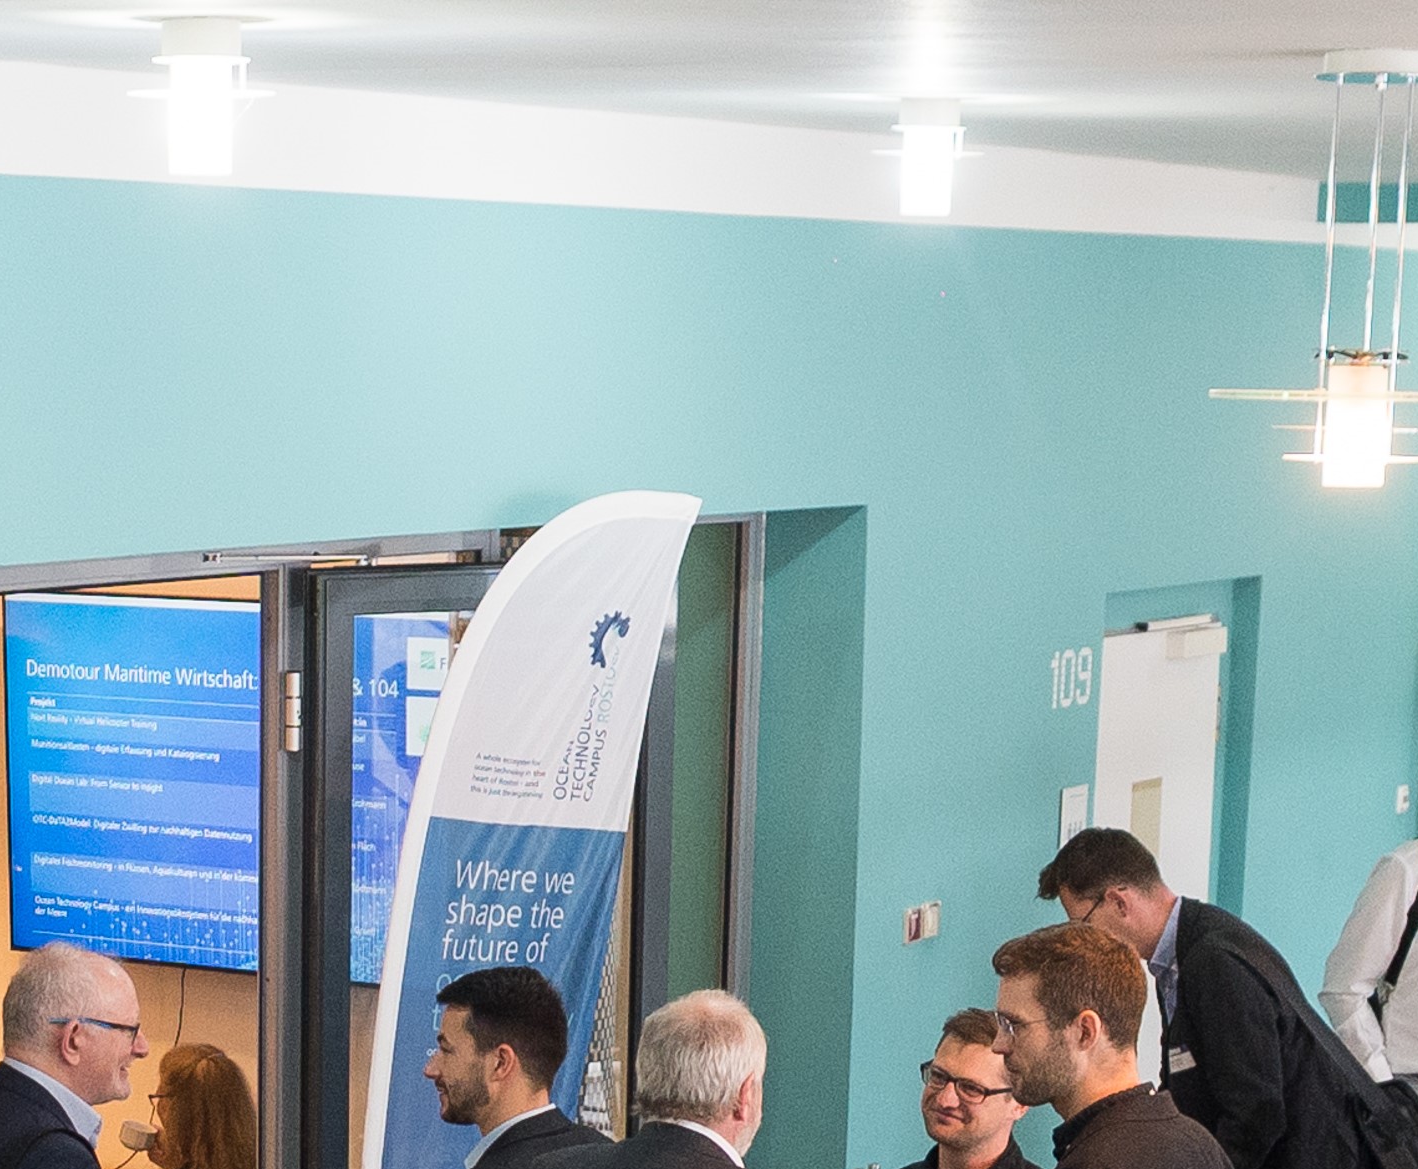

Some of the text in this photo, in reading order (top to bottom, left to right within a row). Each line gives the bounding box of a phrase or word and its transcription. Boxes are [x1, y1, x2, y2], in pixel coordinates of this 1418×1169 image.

[26, 659, 100, 680] Demotour
[104, 664, 171, 684] Maritime
[1051, 646, 1092, 709] 109
[368, 678, 399, 699] 104
[30, 697, 56, 708] Projekt
[131, 719, 157, 732] Training
[154, 747, 167, 757] und
[168, 748, 221, 762] Katalogisierung
[583, 729, 608, 802] CAMPUS
[31, 774, 52, 785] Digital
[204, 828, 252, 844] Datennutzung
[455, 859, 575, 894] Where we
[56, 896, 92, 910] Technology
[446, 895, 564, 933] shape the
[442, 928, 551, 963] future of
